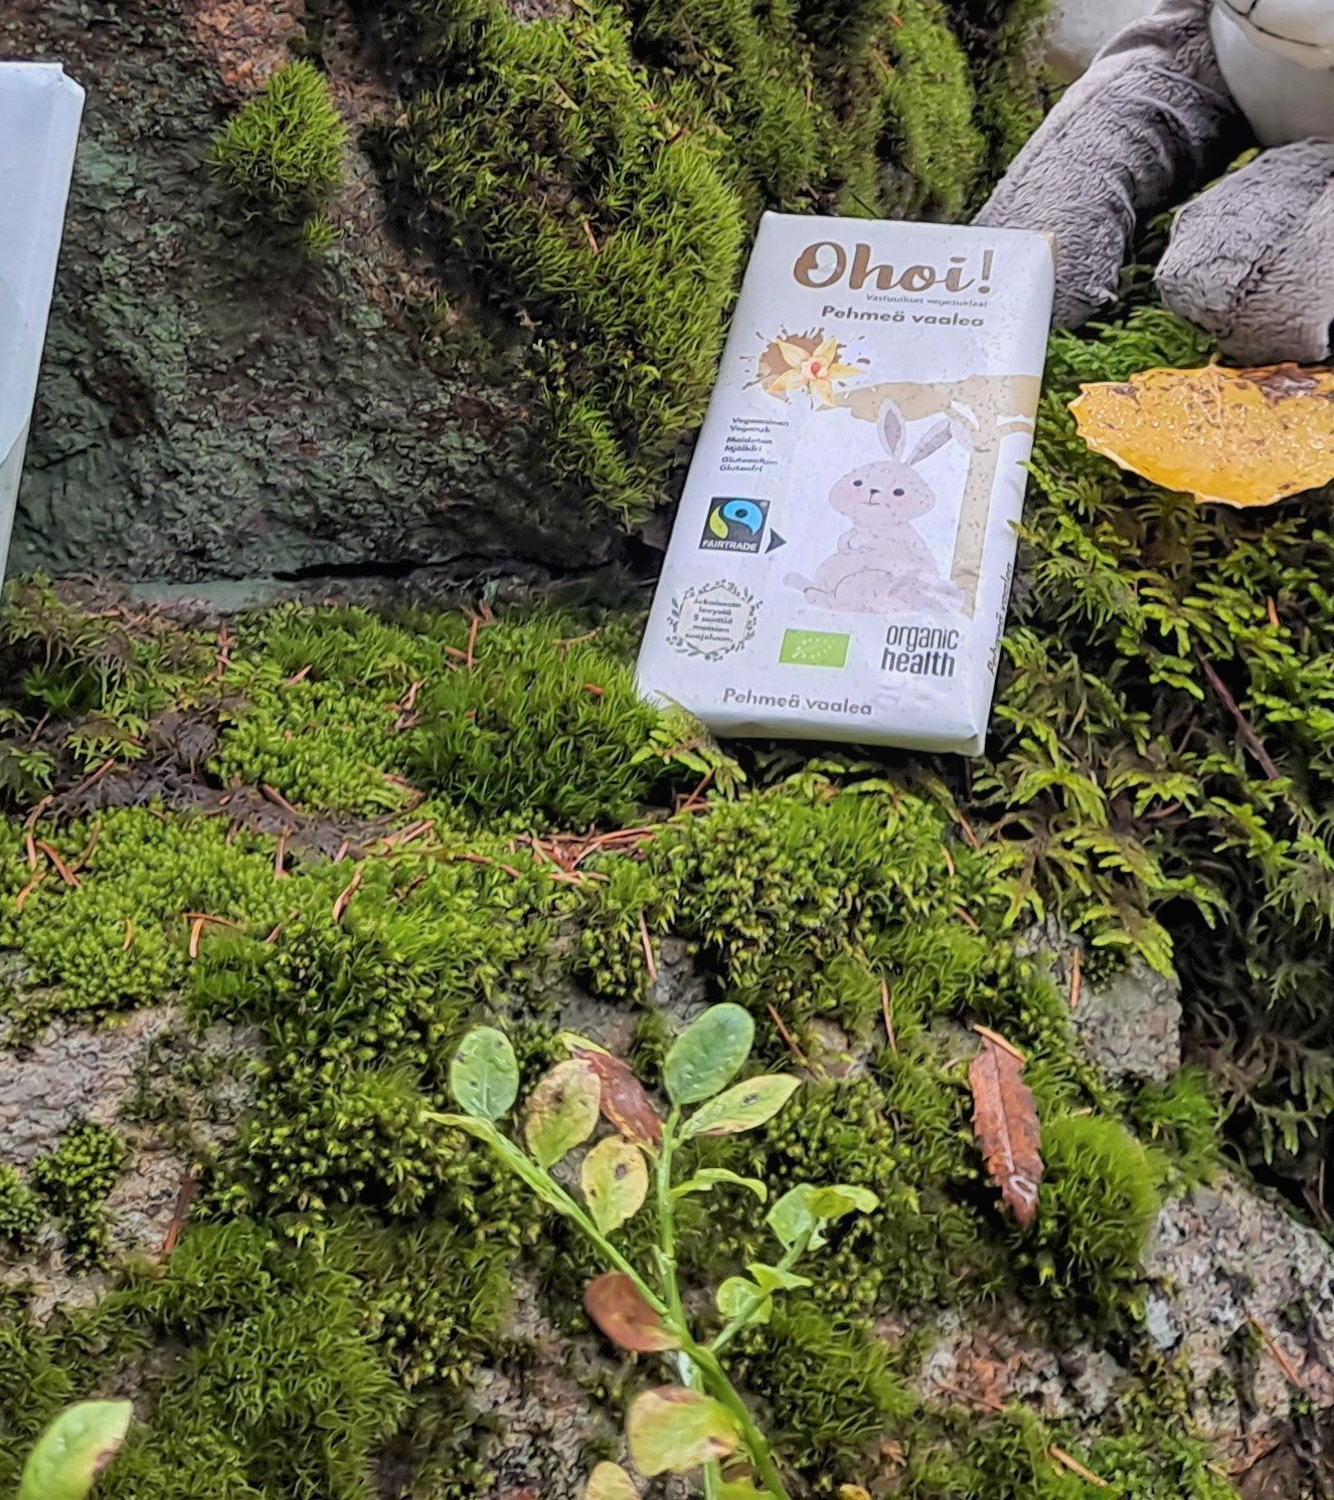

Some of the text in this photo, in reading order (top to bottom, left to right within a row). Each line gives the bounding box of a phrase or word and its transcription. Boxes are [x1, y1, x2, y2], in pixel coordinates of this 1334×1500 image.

[793, 241, 995, 294] Ohoi!
[821, 305, 985, 327] Pehmeä vaalea
[701, 539, 758, 552] FAIRTRADE
[885, 625, 960, 653] organic
[881, 647, 956, 678] health
[723, 687, 872, 715] Pehmeä vaalea
